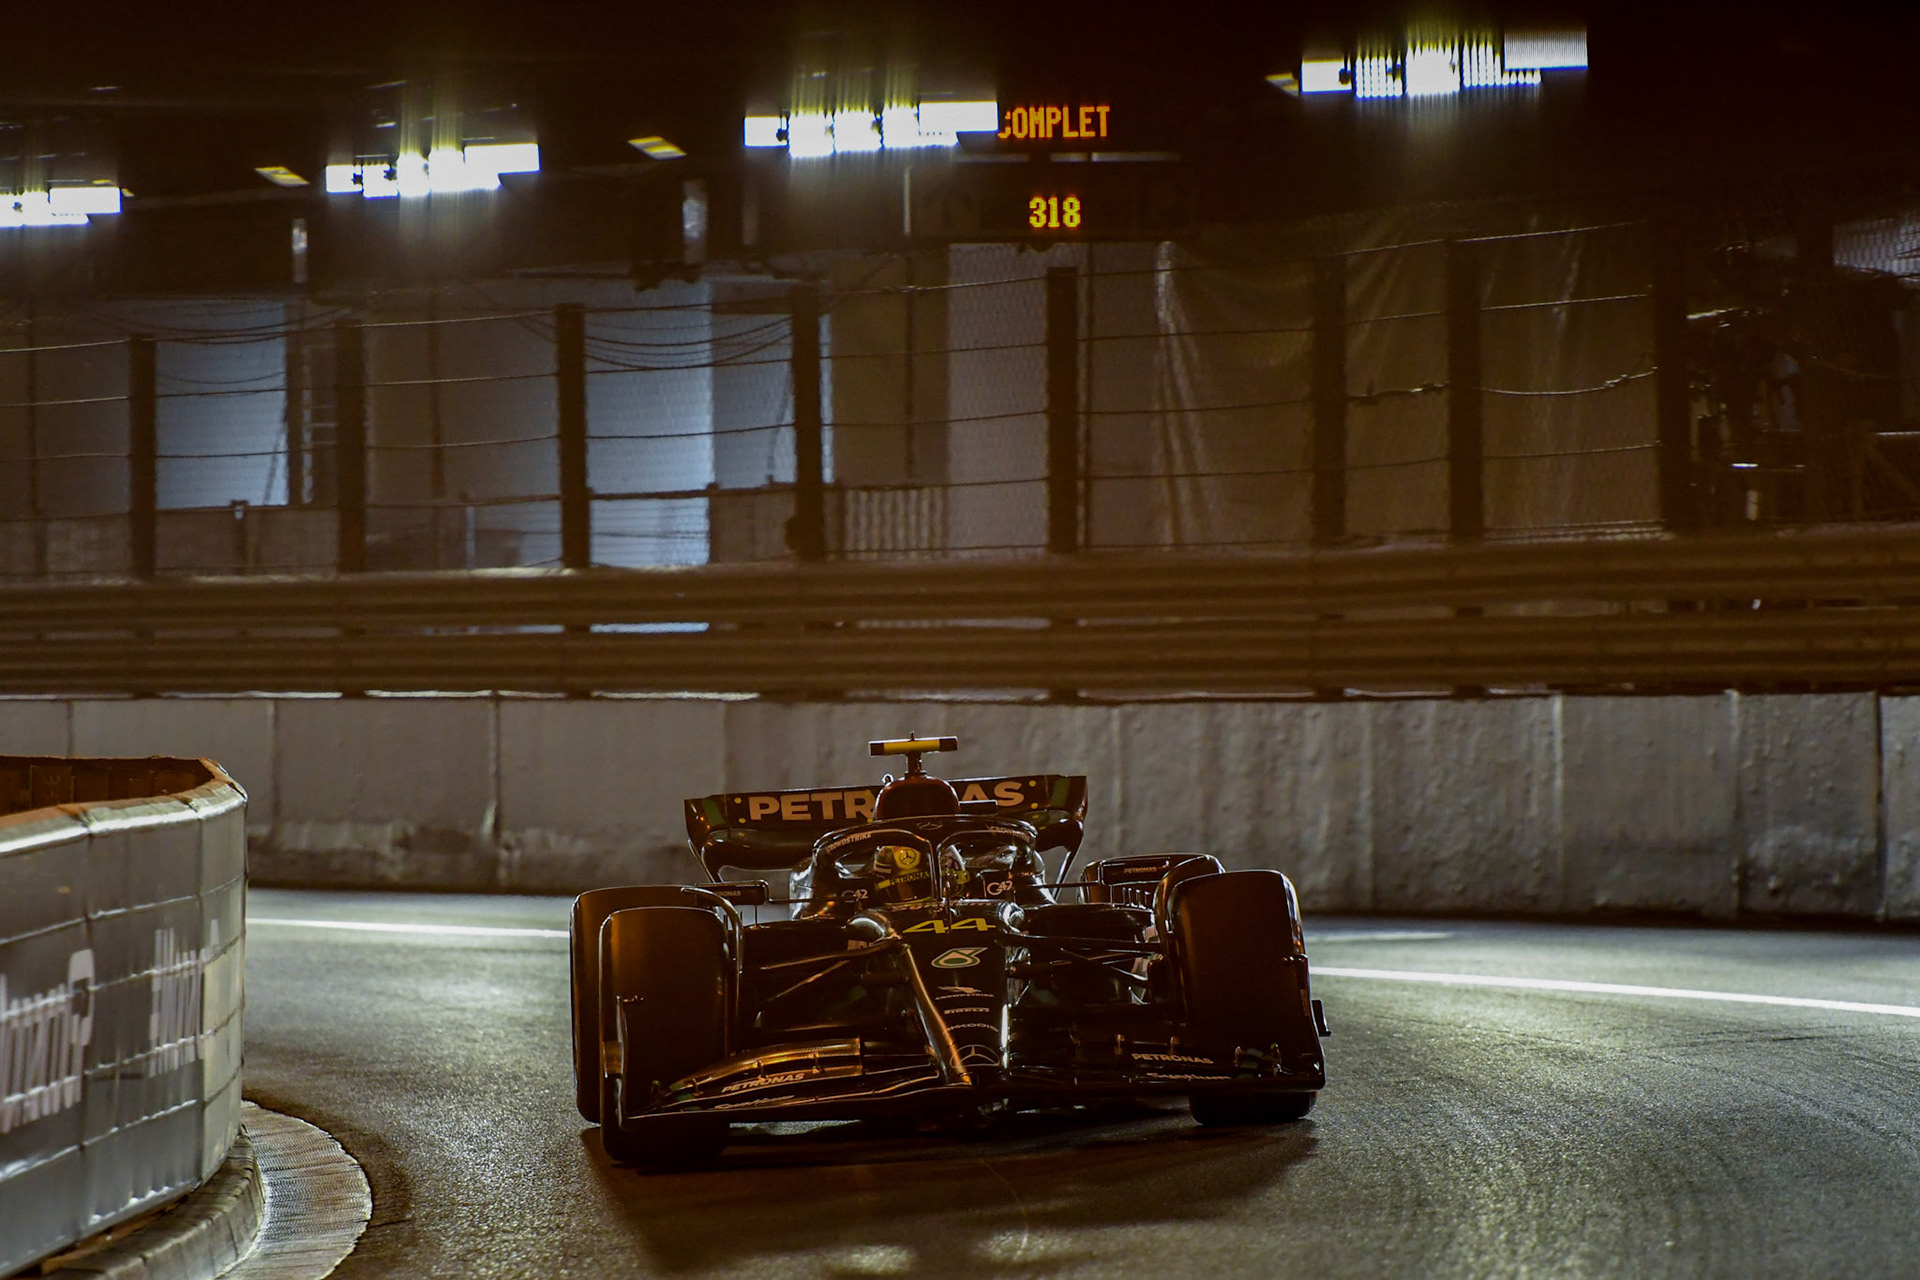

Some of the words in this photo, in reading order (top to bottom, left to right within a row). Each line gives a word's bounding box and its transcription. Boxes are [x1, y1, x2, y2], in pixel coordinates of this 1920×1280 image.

[1028, 196, 1082, 228] 318
[748, 780, 1026, 821] PETRAS
[902, 917, 997, 934] 44
[1130, 1053, 1215, 1065] PETRONAS
[720, 1073, 806, 1094] PETRONAS
